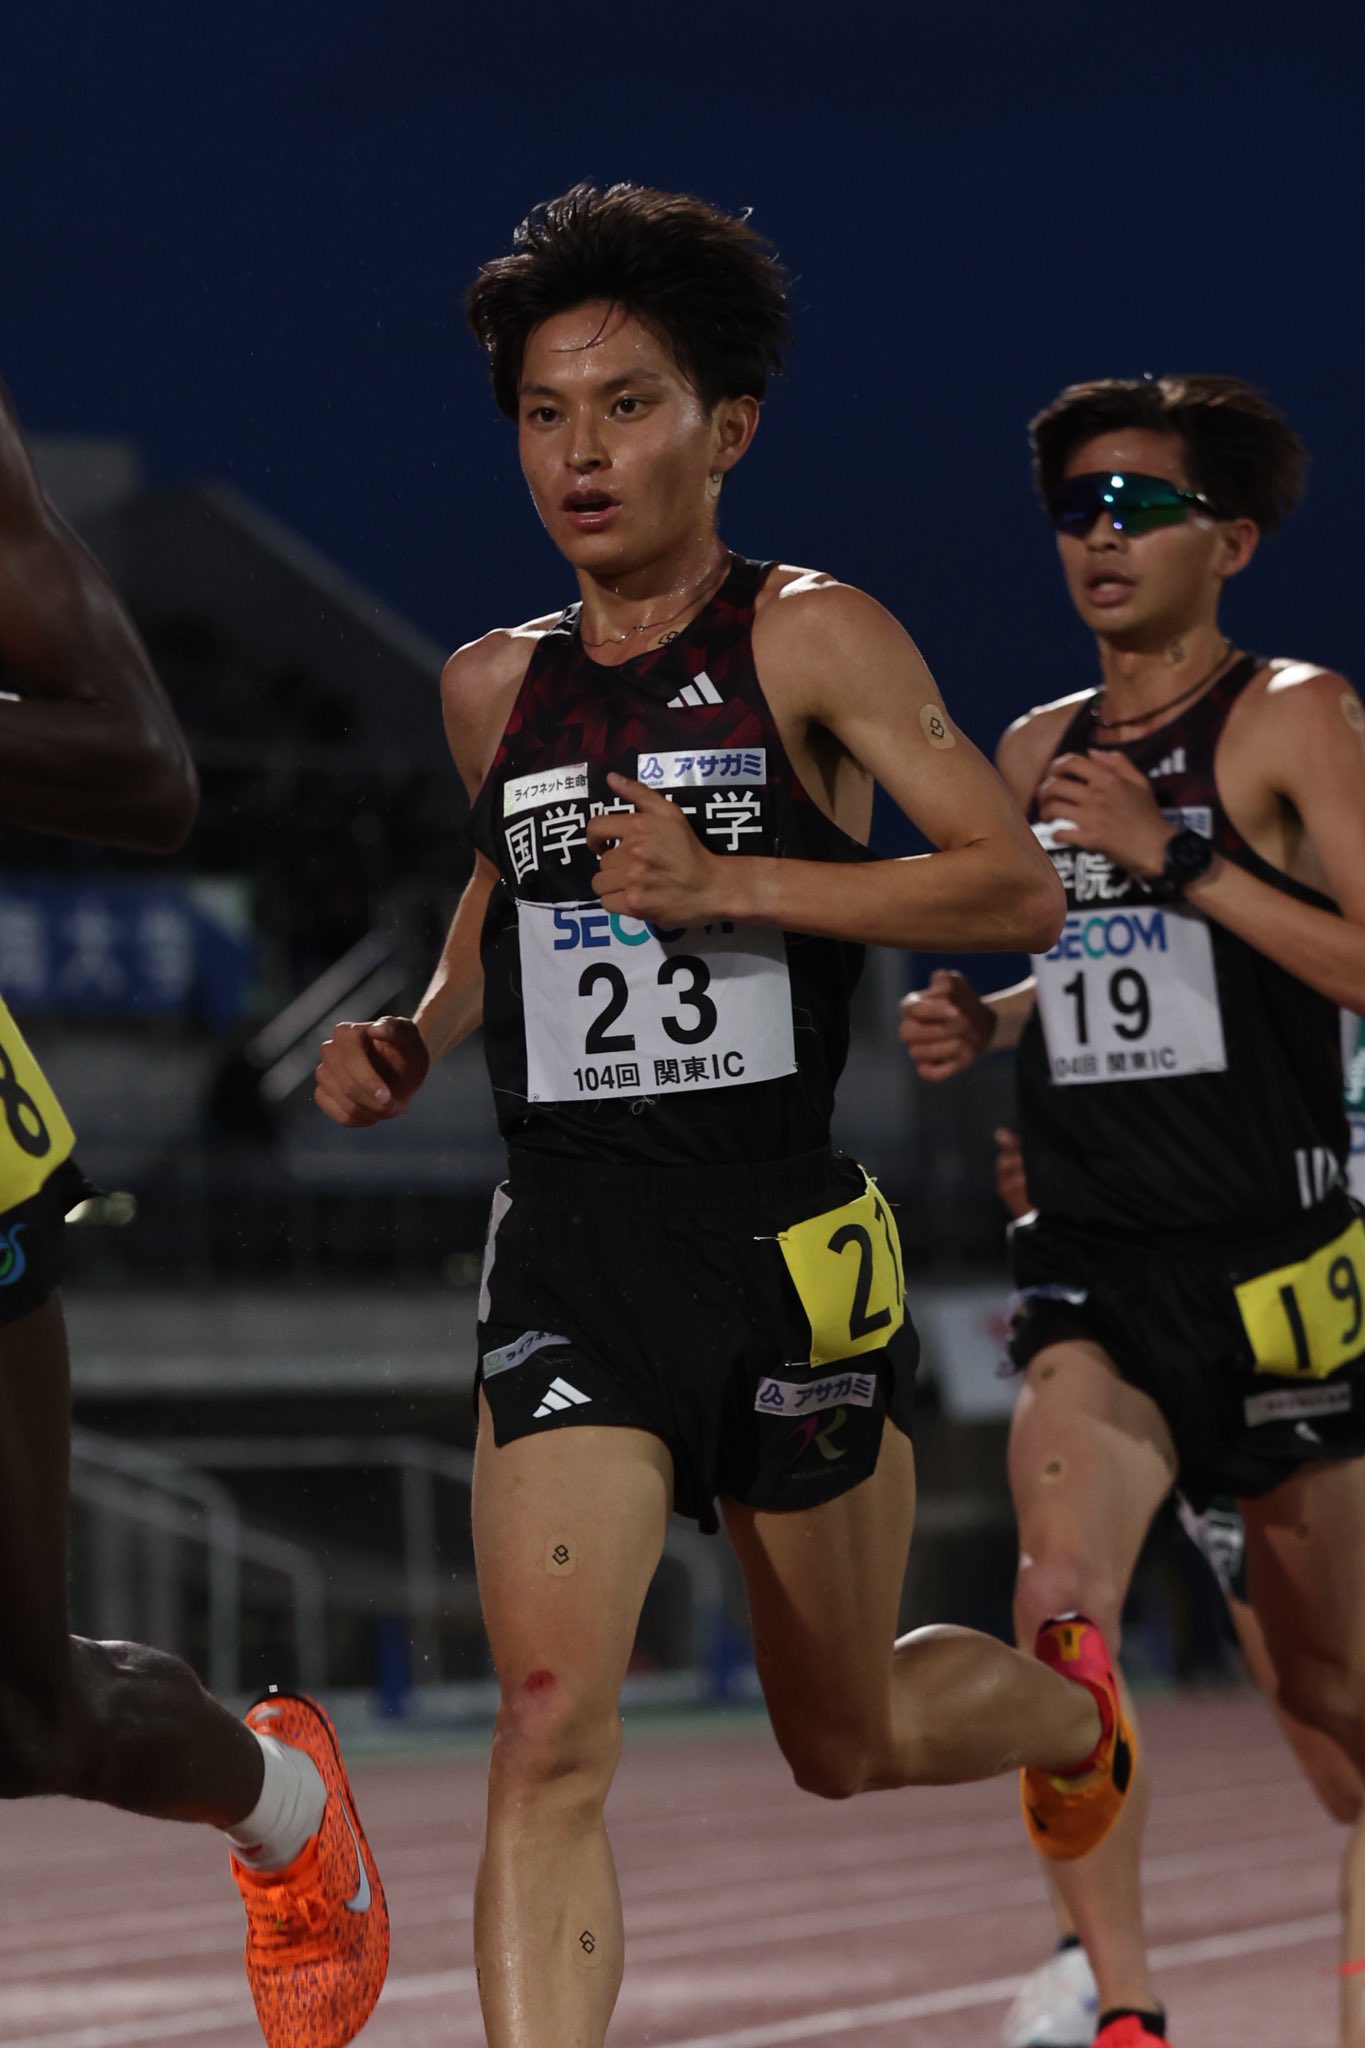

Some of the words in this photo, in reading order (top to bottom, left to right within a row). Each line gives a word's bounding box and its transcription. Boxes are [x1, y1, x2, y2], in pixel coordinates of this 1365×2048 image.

[674, 753, 763, 777] アサガミ
[514, 774, 588, 803] ライフネット生命
[578, 954, 718, 1055] 23
[1063, 967, 1151, 1046] 19
[573, 1066, 640, 1091] 104回
[653, 1051, 745, 1086] 関東IC
[1279, 1254, 1363, 1371] 19
[795, 1376, 873, 1408] アサガミ
